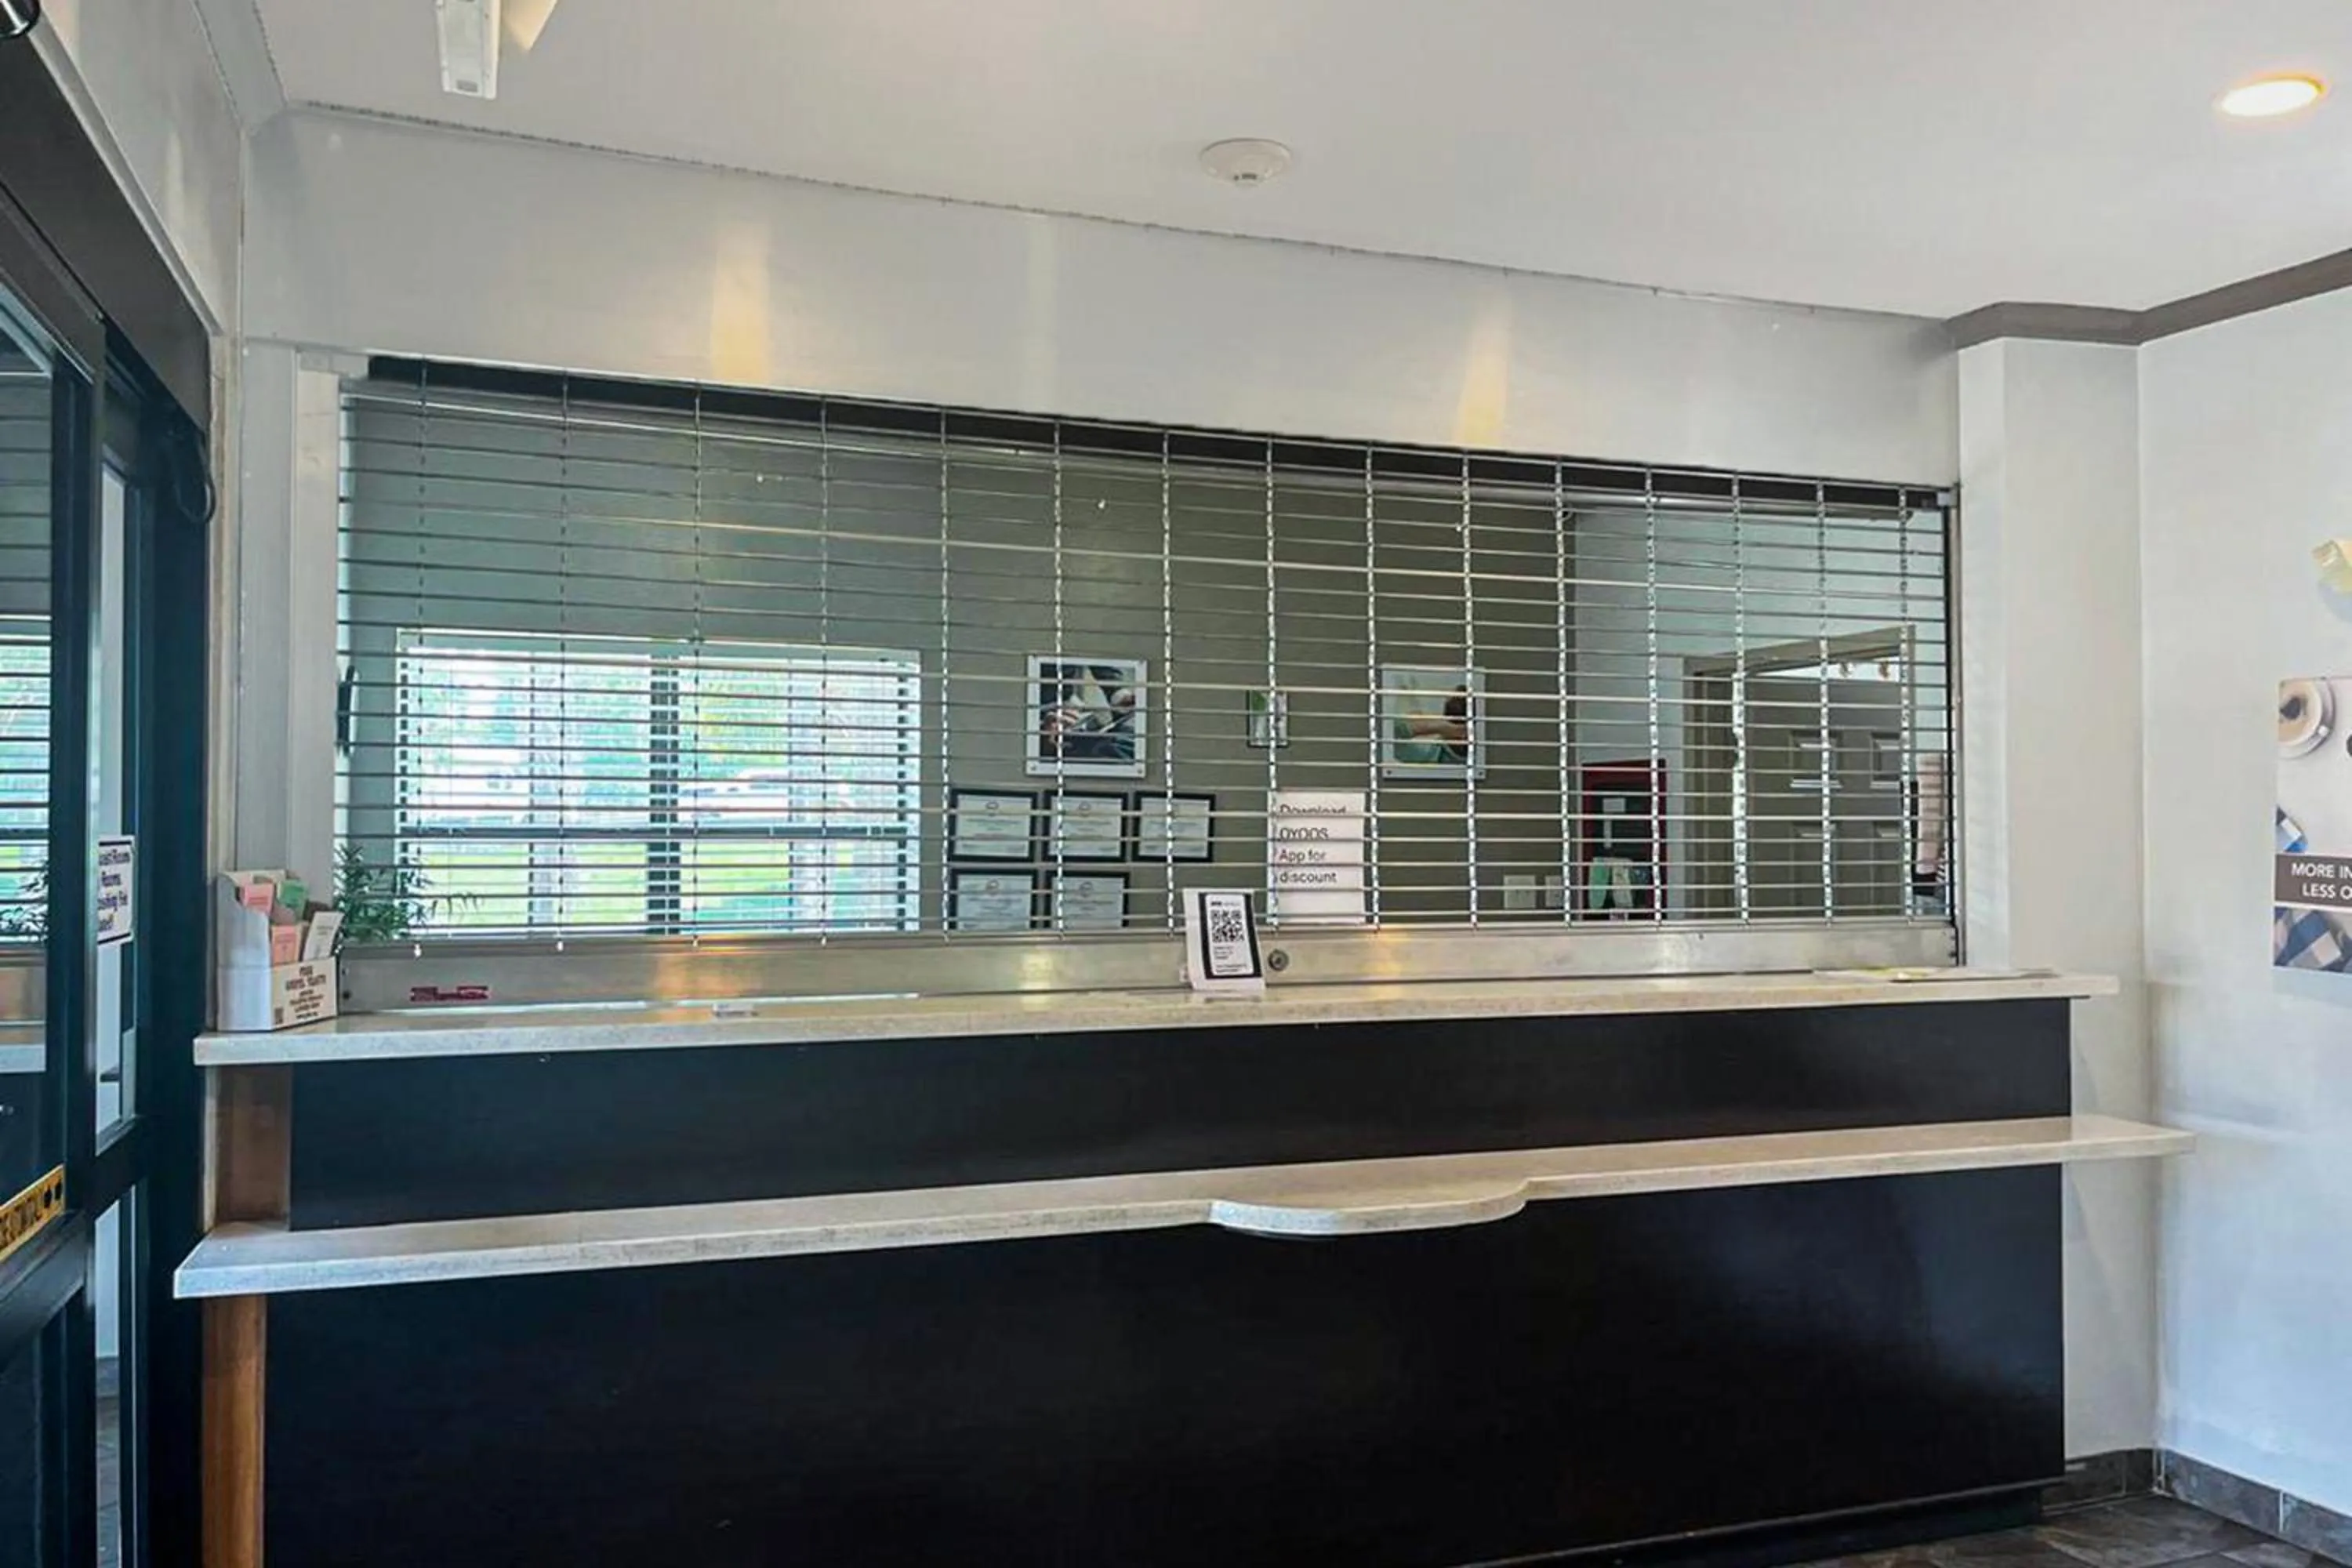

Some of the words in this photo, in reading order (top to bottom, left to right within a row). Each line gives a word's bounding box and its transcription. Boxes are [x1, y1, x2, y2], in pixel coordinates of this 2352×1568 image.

[1279, 849, 1305, 862] App
[1308, 849, 1327, 861] for
[2291, 862, 2335, 878] MORE
[1279, 871, 1338, 884] discount
[2302, 883, 2336, 899] LESS
